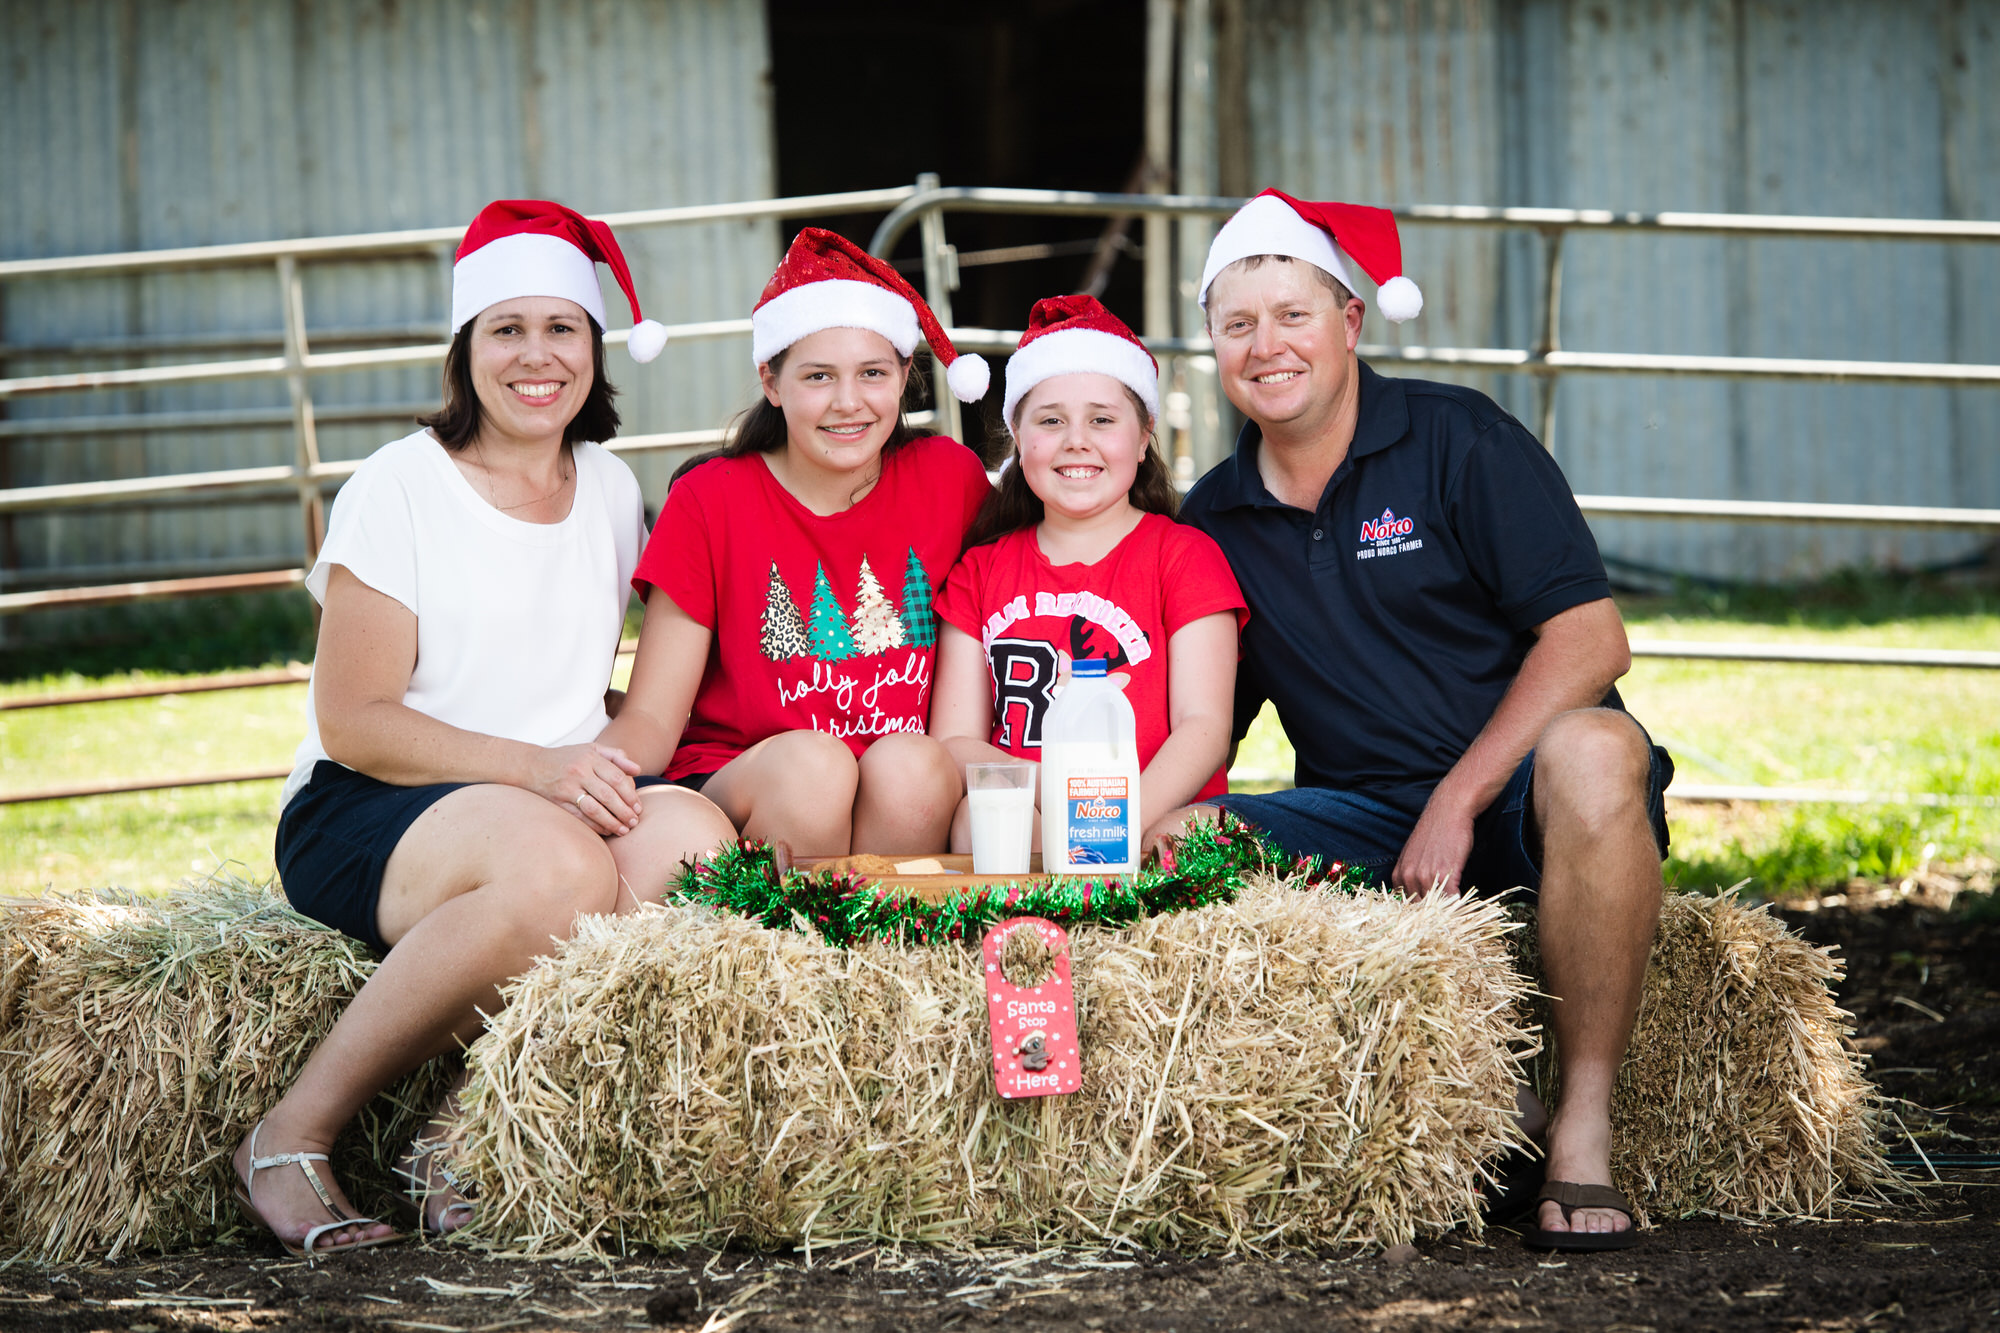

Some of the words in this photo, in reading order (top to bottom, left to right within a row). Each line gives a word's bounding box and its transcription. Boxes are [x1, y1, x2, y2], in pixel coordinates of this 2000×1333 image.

[1360, 517, 1414, 542] Norco
[1356, 548, 1375, 560] PROUD
[1377, 545, 1397, 557] NORCO
[1398, 539, 1423, 553] FARMER
[778, 662, 858, 710] holly
[989, 637, 1059, 748] R
[812, 706, 925, 739] hristmas
[1069, 787, 1099, 796] FARMER
[1100, 787, 1126, 796] OWNED
[1087, 778, 1126, 787] AUSTRALIAN
[1075, 801, 1121, 819] Norco
[1069, 826, 1100, 838] fresh
[1103, 826, 1127, 838] milk
[1007, 1000, 1056, 1018] Santa
[1018, 1017, 1047, 1030] Stop
[1016, 1073, 1060, 1090] Here
